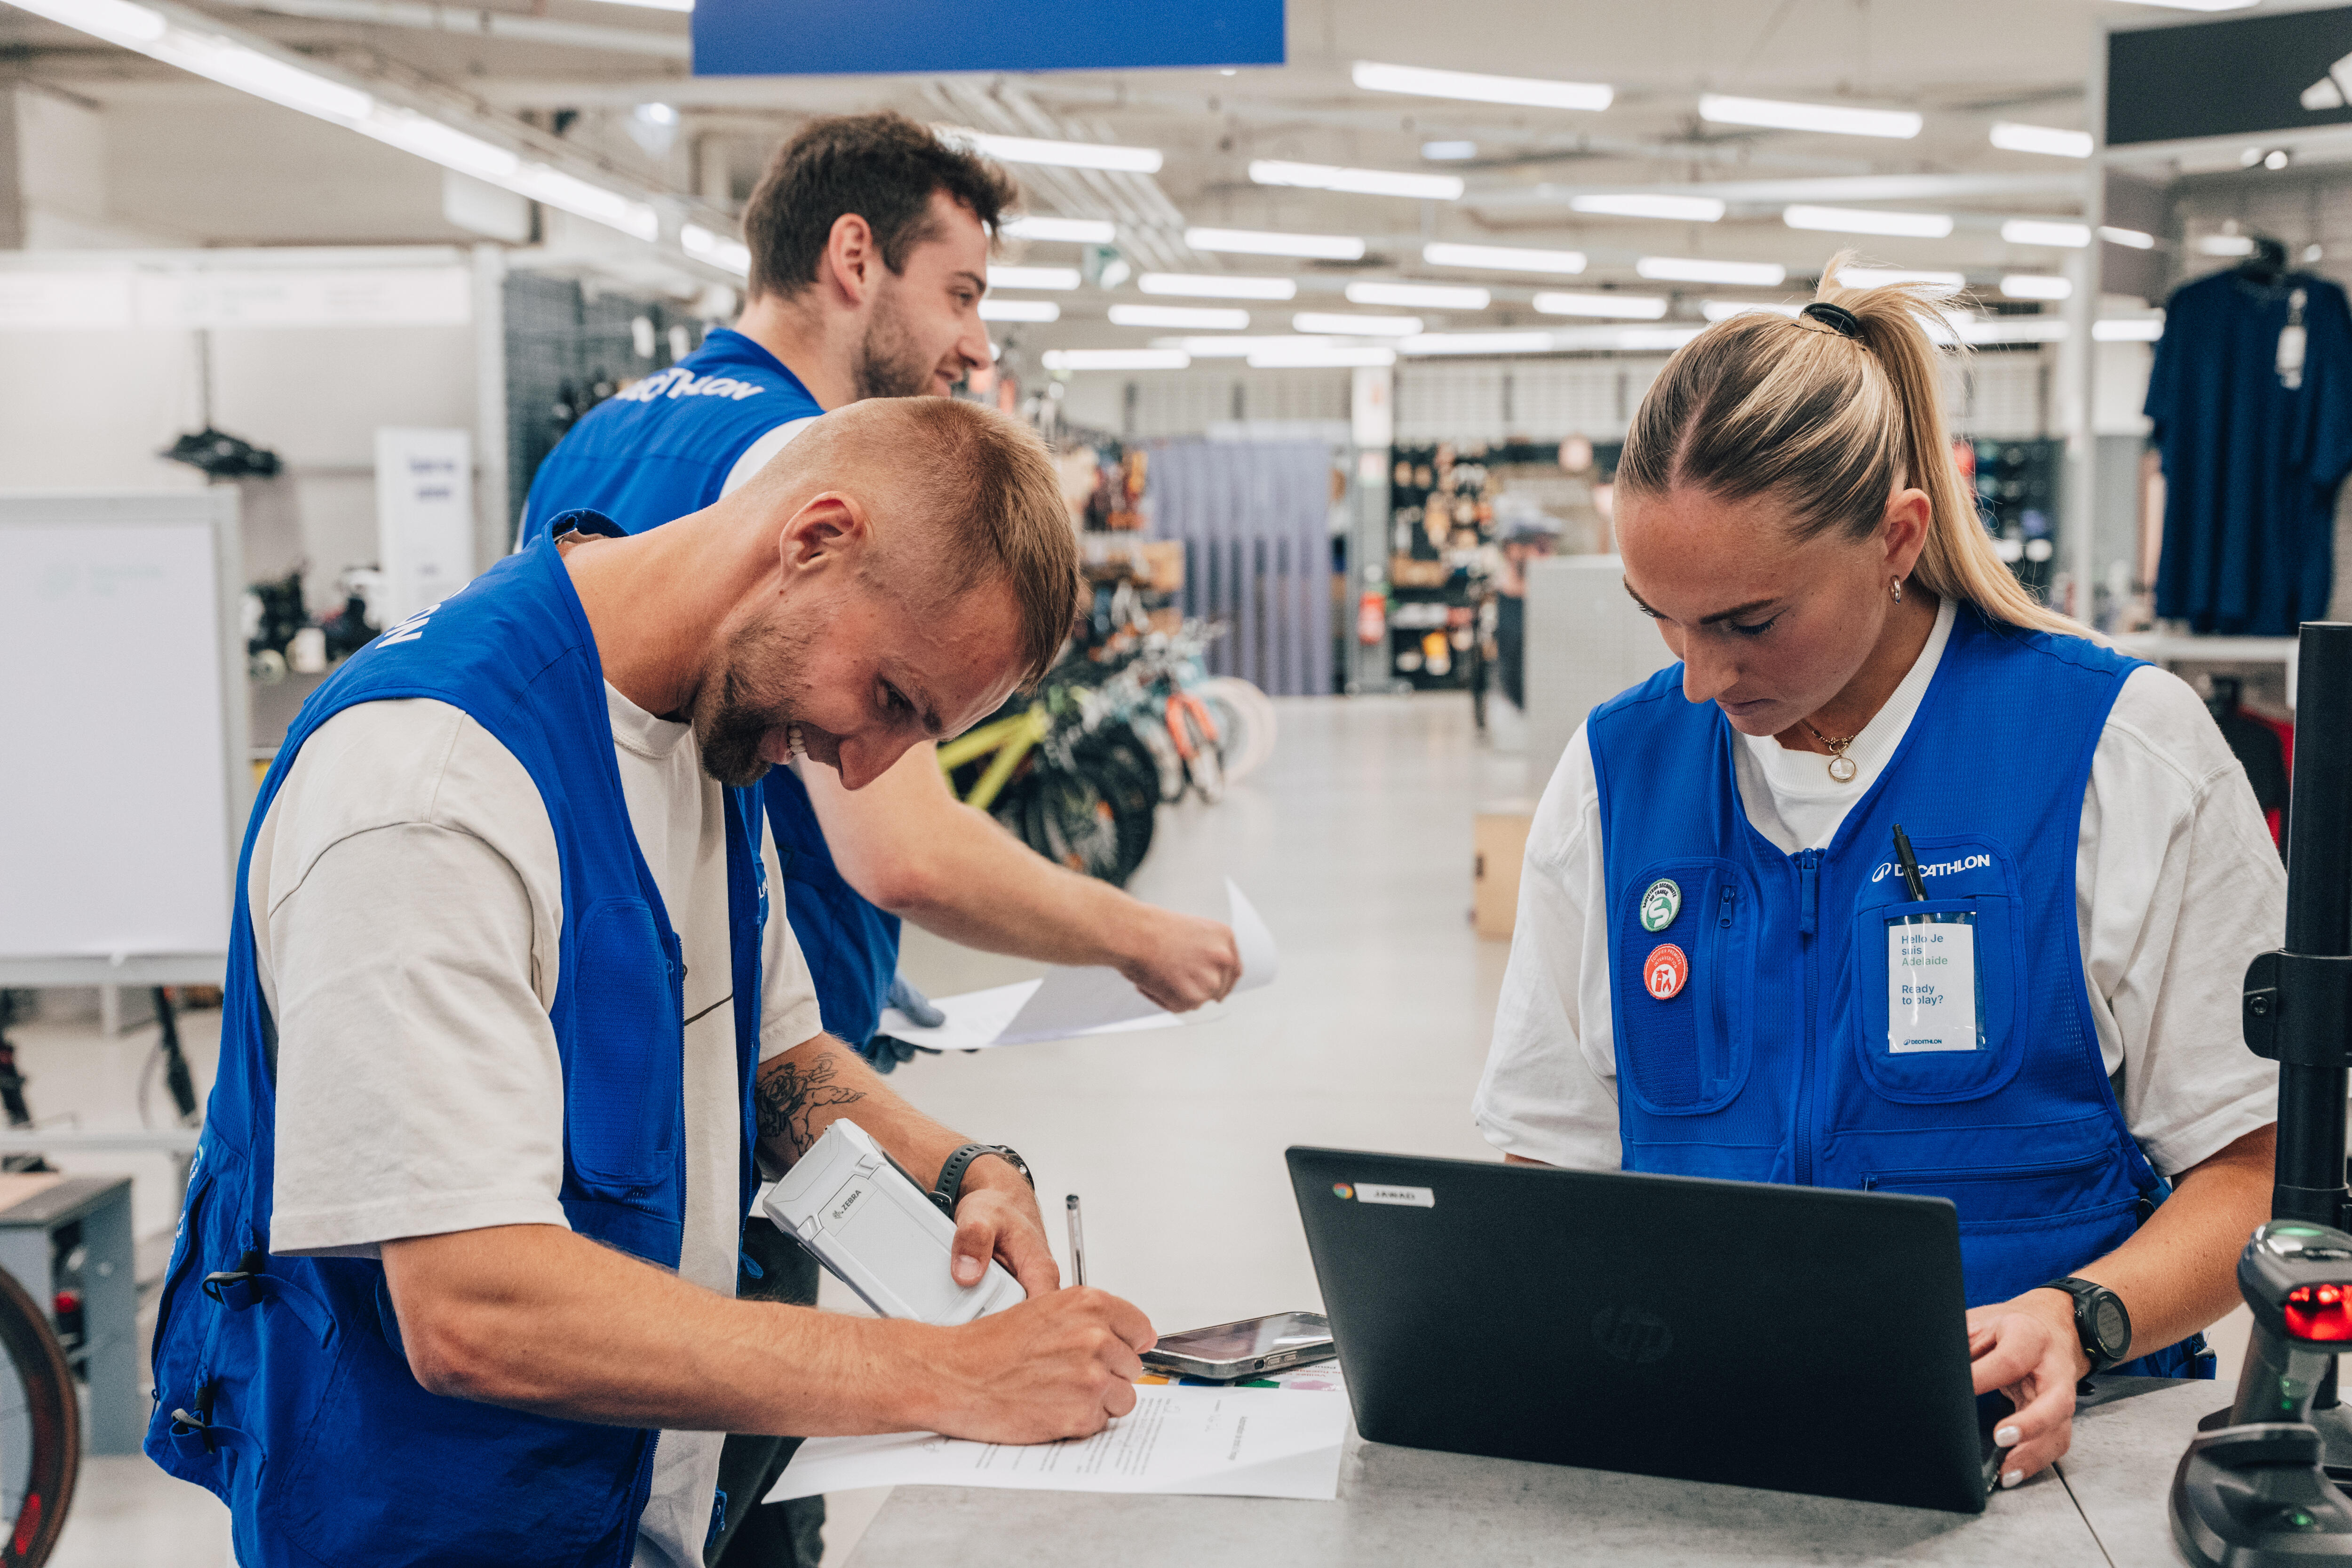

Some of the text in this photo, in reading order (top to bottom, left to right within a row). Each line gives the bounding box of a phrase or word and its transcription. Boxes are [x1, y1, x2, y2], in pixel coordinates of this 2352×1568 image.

[1894, 854, 1990, 877] DCATHLON
[1901, 934, 1944, 944] Hello Je
[1901, 946, 1923, 955] suis
[1653, 955, 1678, 969] INTERVENTION
[1901, 956, 1948, 966] Adelaide
[1901, 984, 1935, 995] Ready
[841, 1190, 862, 1211] ZEBRA
